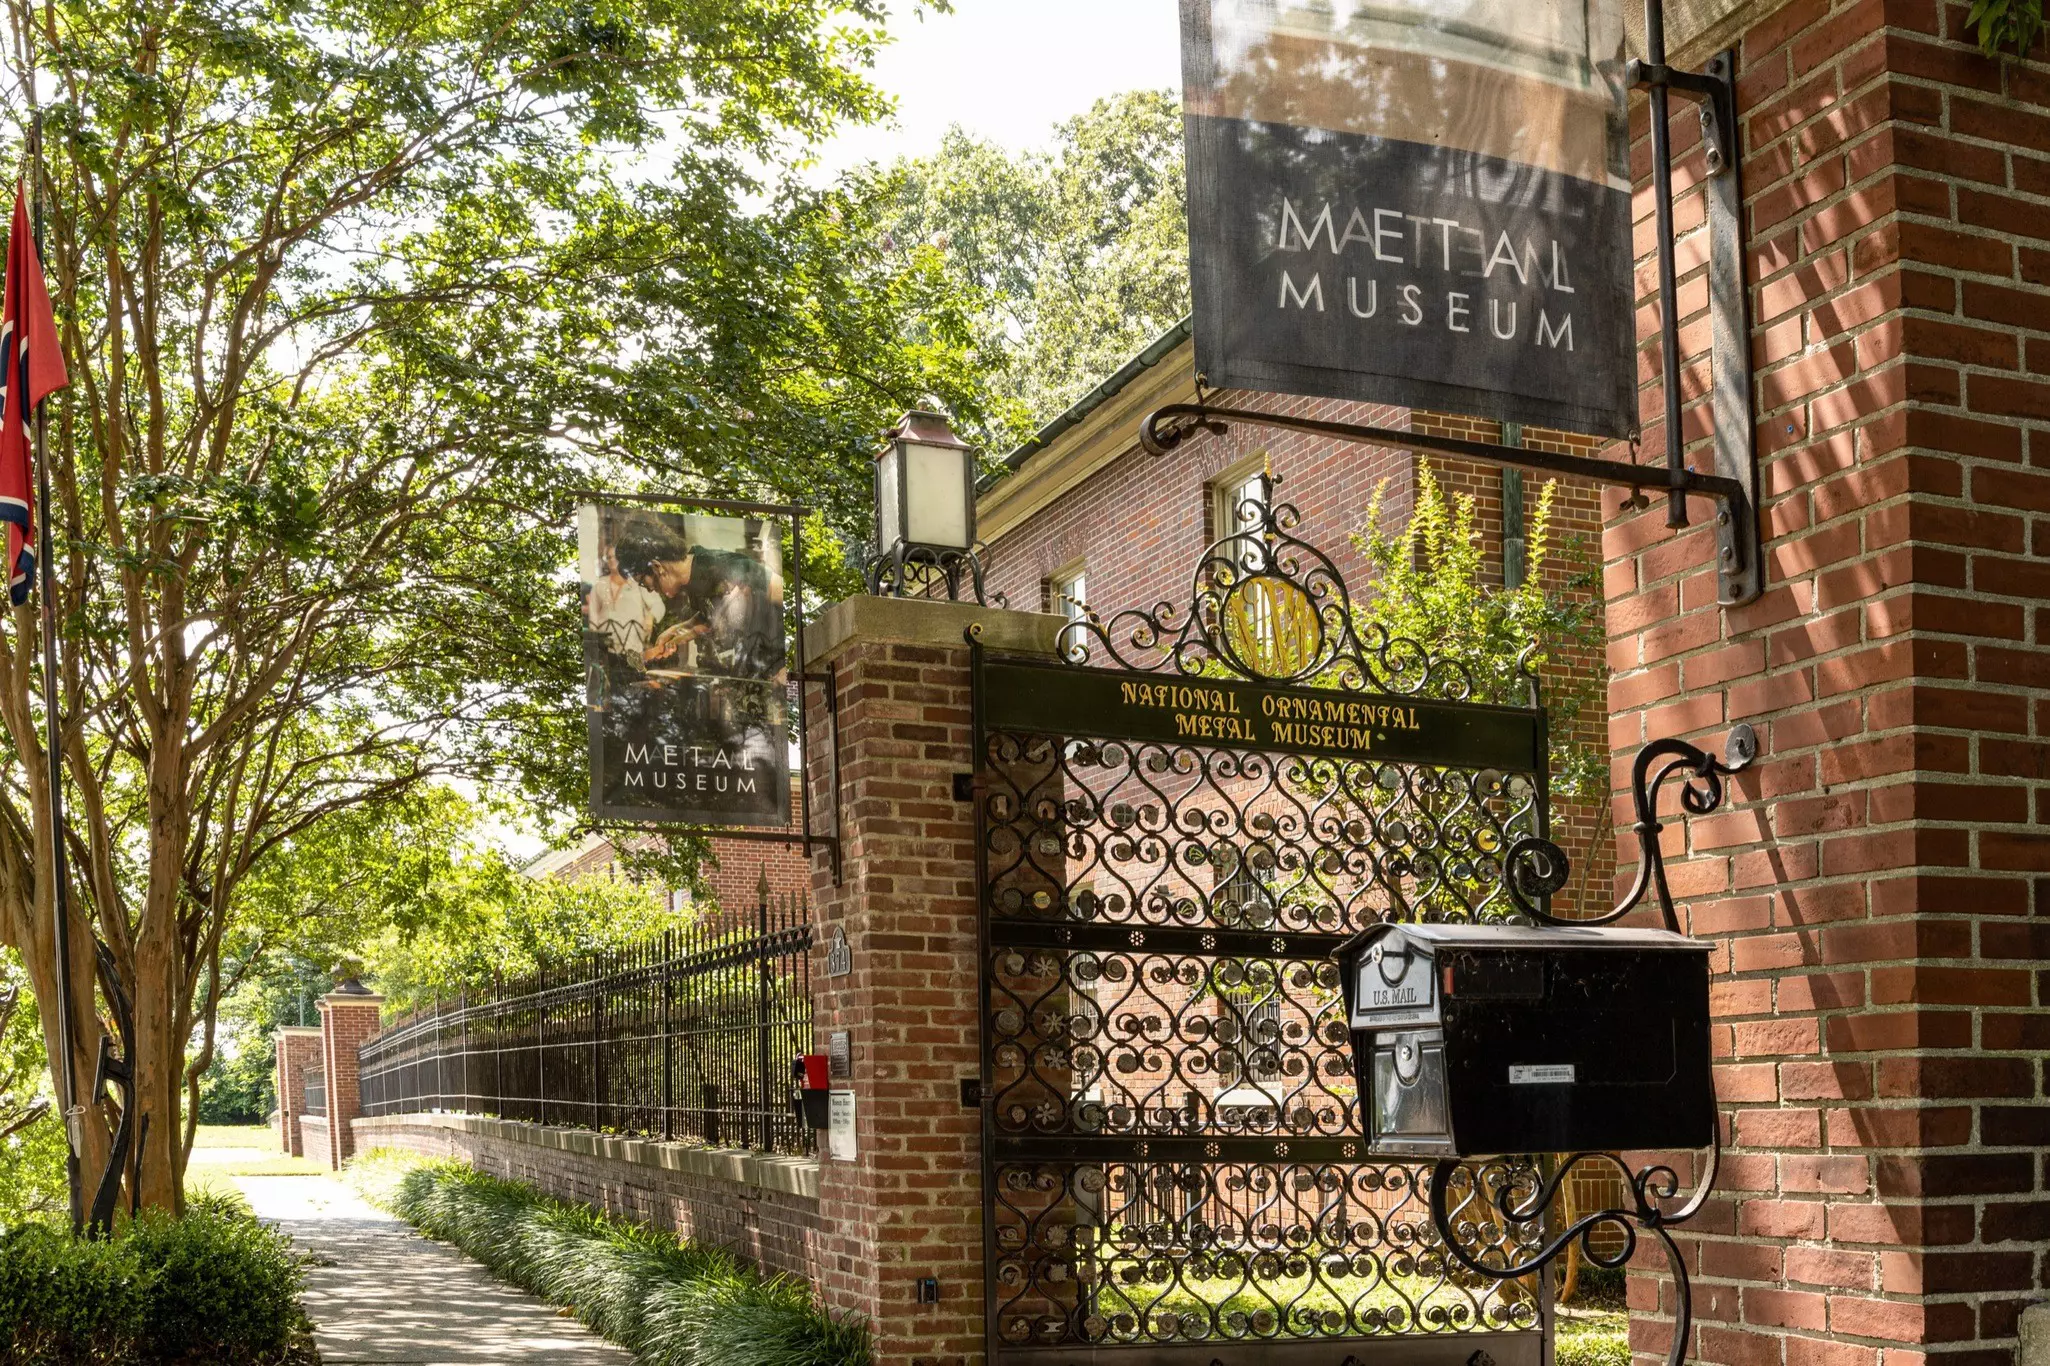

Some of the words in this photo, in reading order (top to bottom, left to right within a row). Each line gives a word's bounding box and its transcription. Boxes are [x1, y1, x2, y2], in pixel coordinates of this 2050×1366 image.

[1279, 197, 1575, 294] METAL
[1279, 270, 1574, 352] MUSEUM
[1120, 682, 1240, 714] NATIONAL
[1262, 695, 1420, 730] ORNAMENTAL
[1175, 713, 1256, 741] METAL
[1271, 721, 1371, 750] MUSEUM
[624, 743, 755, 772] METAL
[624, 771, 756, 793] MUSEUM
[1373, 990, 1390, 1006] U.S.
[1391, 988, 1417, 1005] MAIL
